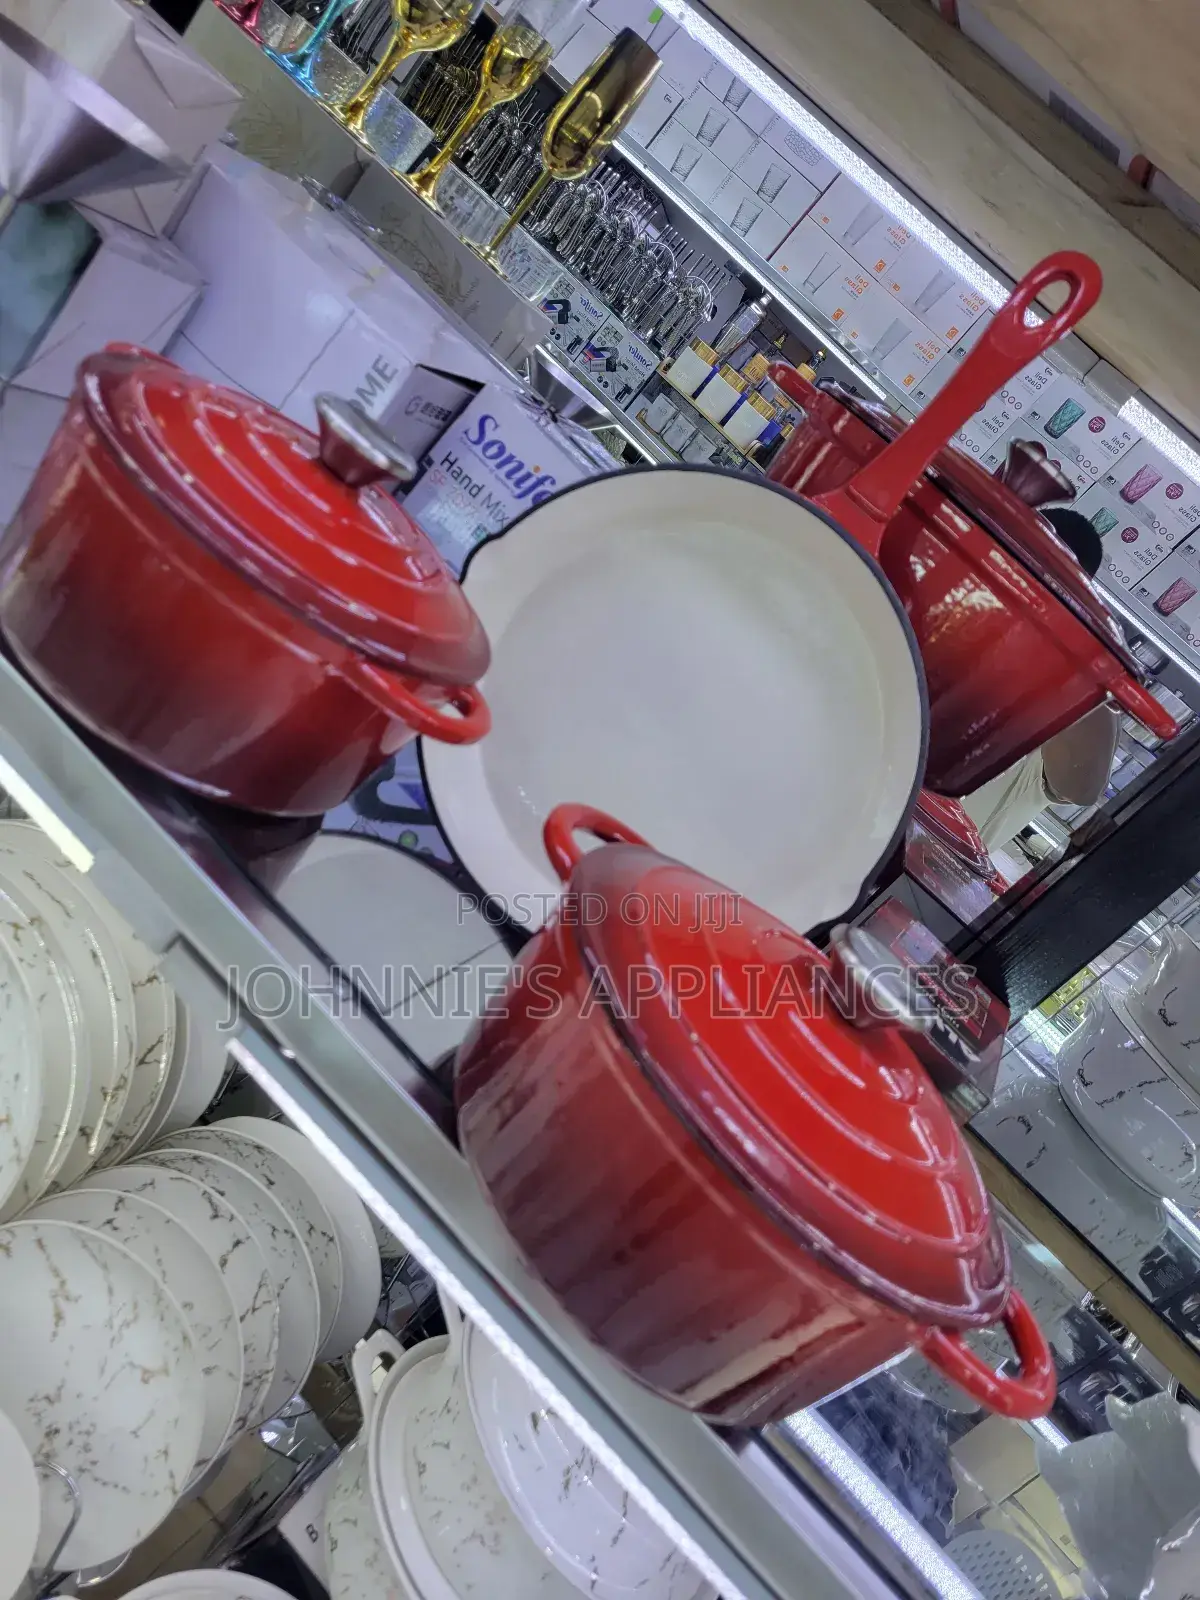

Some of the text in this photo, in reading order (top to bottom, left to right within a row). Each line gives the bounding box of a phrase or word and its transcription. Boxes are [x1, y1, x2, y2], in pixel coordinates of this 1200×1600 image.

[440, 450, 485, 498] Hand
[480, 492, 510, 529] Mix
[464, 413, 557, 506] Sonife
